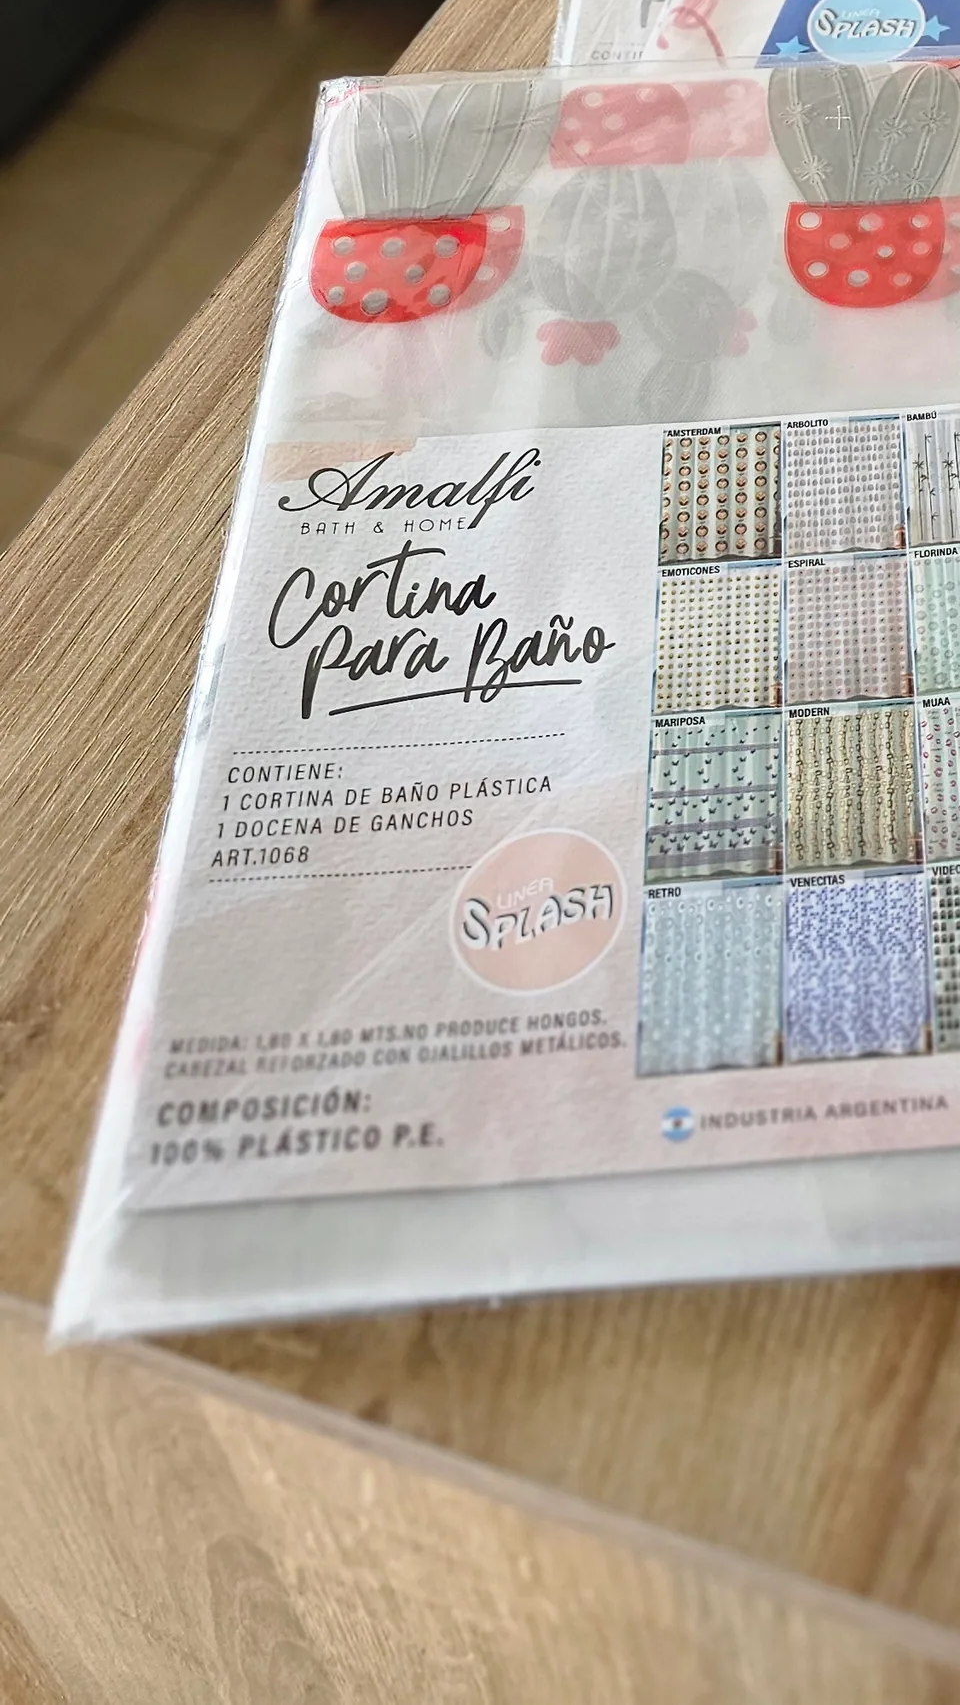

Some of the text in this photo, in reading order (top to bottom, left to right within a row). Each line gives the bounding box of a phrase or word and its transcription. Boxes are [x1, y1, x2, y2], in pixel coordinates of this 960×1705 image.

[786, 418, 829, 430] ARBOLITO
[906, 410, 937, 422] BAMBÚ
[278, 447, 543, 530] Amalfi
[300, 516, 467, 536] BATH & HOME
[788, 557, 826, 569] ESPIRAL
[913, 546, 959, 559] FLORINDA
[661, 564, 721, 578] EMOTICONES
[268, 539, 497, 649] Cortina
[462, 614, 616, 705] Baño
[788, 706, 831, 719] MODERN
[921, 696, 951, 709] MUAA
[654, 715, 706, 728] MARIPOSA
[227, 762, 345, 784] CONTIENE:
[221, 774, 553, 812] 1 CORTINA DE BAÑO PLÁSTICA
[216, 807, 475, 839] 1 DOCENA DE GANCHOS
[210, 844, 311, 868] ART.1068
[789, 874, 846, 888] VENECITAS
[648, 886, 682, 900] RETRO
[460, 882, 614, 951] SPLASH
[435, 1015, 519, 1039] PRODUCE
[526, 1008, 607, 1031] HONGOS.
[372, 1046, 410, 1067] CON
[156, 1087, 372, 1128] COMPOSICIÓN:
[699, 1093, 950, 1131] INDUSTRIA ARGENTINA
[149, 1121, 445, 1168] 100% PLÁSTICO P.E.
